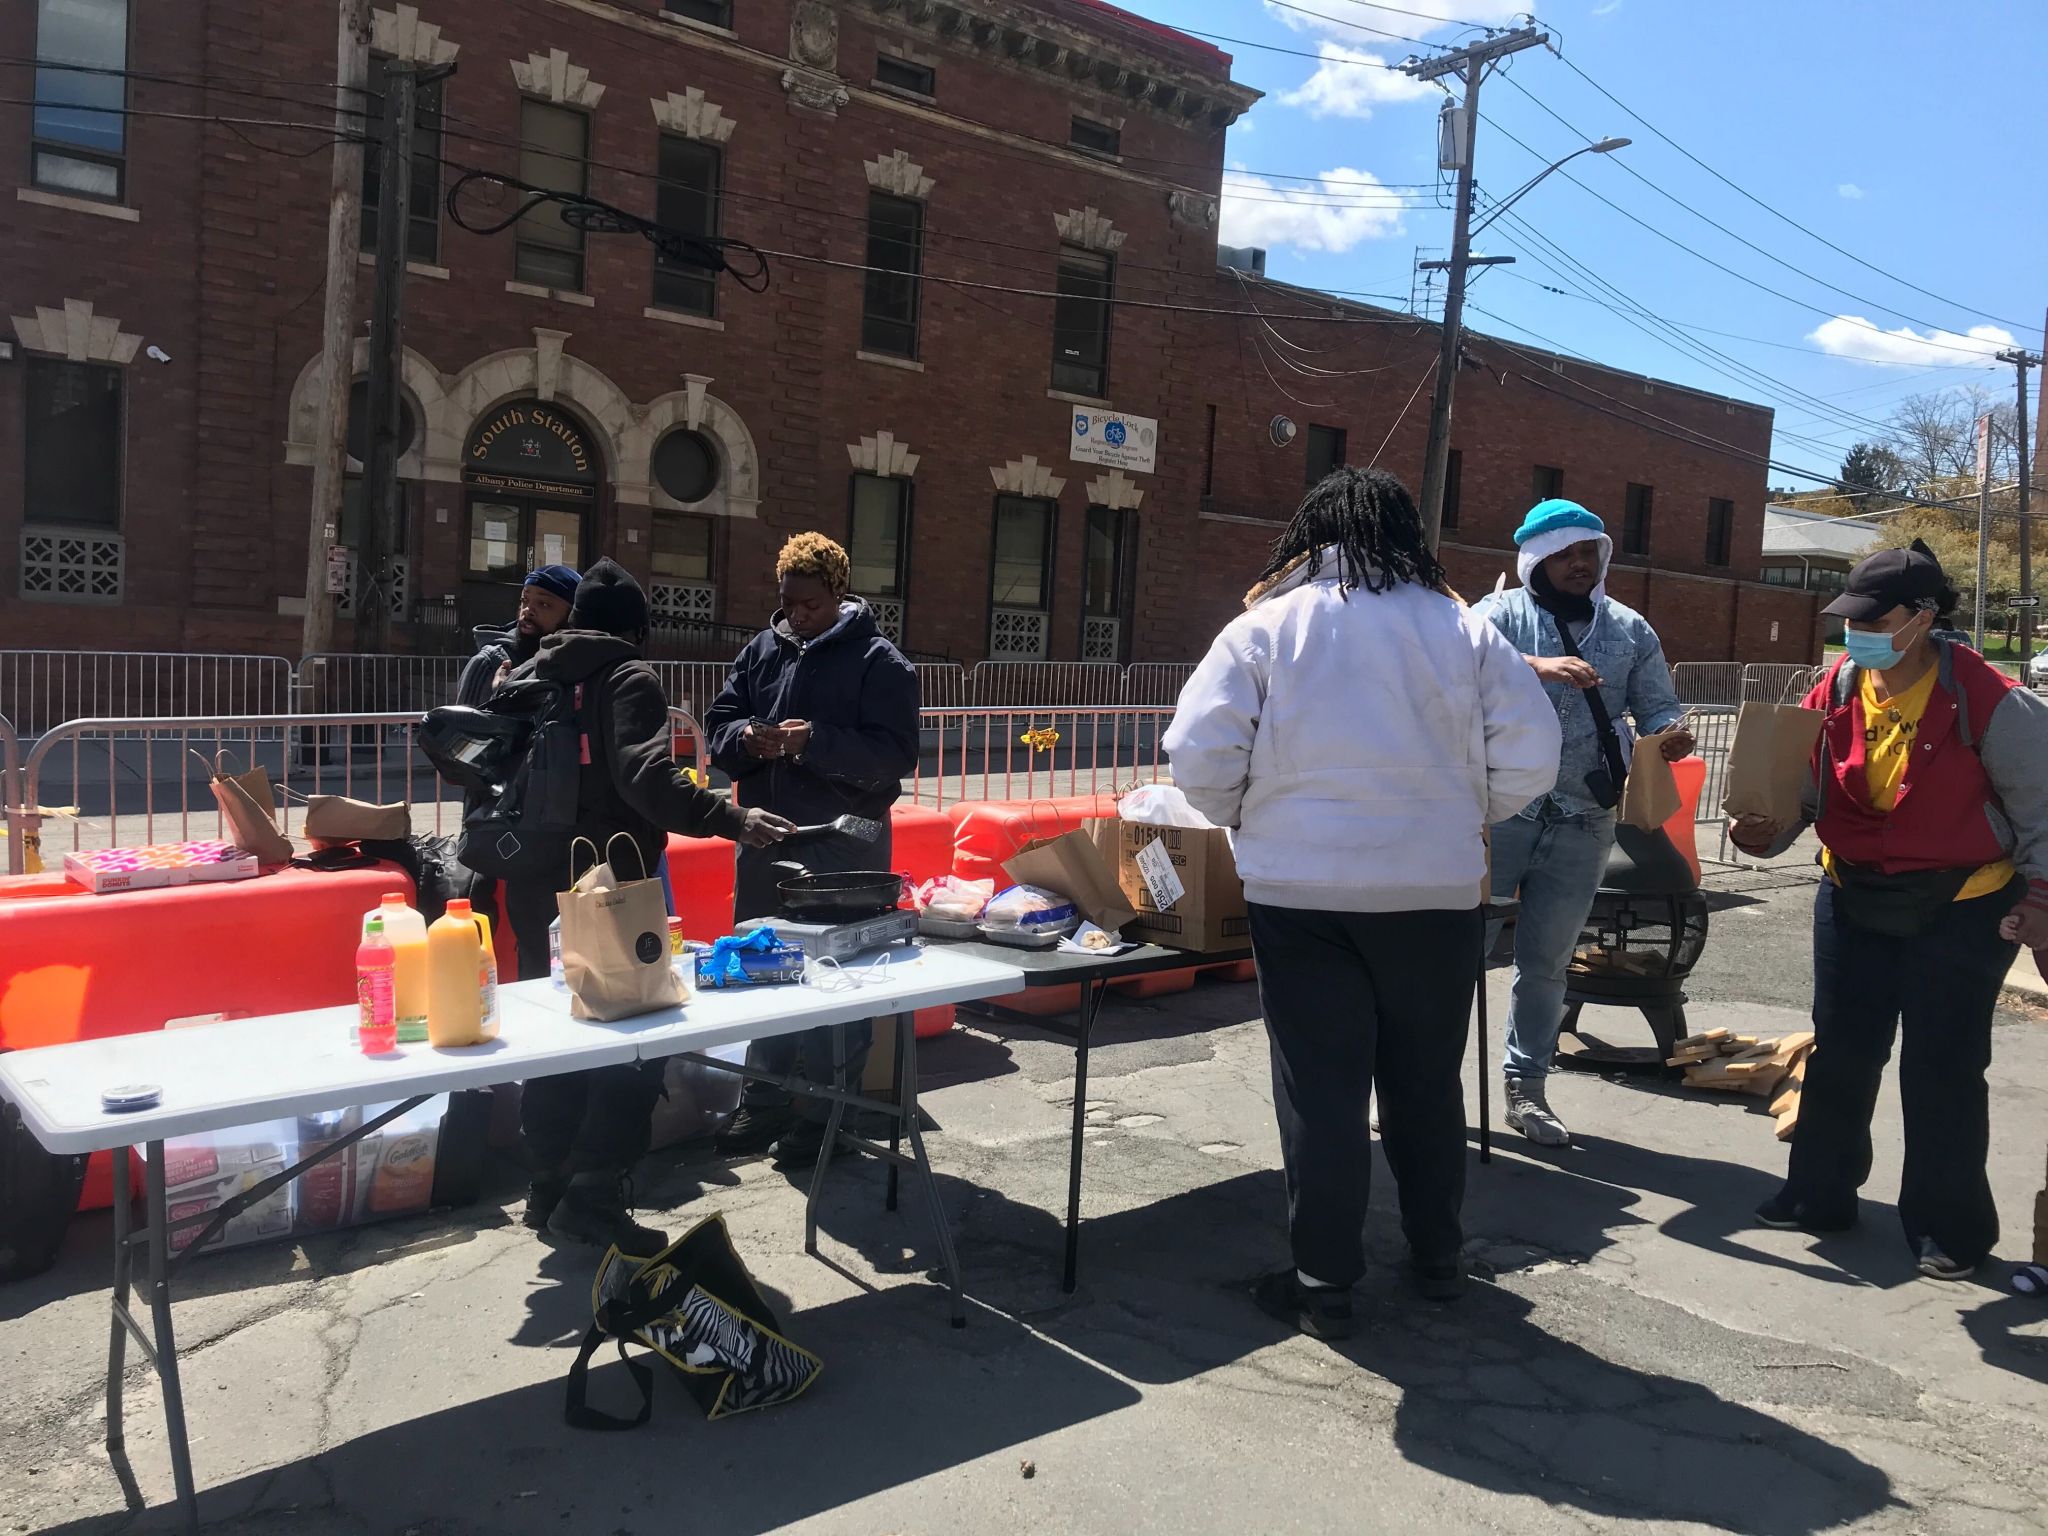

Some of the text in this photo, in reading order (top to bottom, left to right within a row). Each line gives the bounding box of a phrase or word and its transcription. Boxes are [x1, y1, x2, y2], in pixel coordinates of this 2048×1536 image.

[1091, 413, 1120, 425] Bicycle
[1122, 416, 1139, 434] Lock
[472, 408, 589, 473] South Station
[1075, 445, 1092, 453] Guard
[1093, 447, 1104, 455] Your
[1105, 449, 1121, 458] Bicycle
[1139, 455, 1151, 463] Theft
[475, 475, 583, 496] Albany Police Department
[324, 528, 335, 538] 19
[102, 881, 130, 889] DONUTS
[1154, 889, 1169, 910] 256
[698, 973, 715, 982] 100
